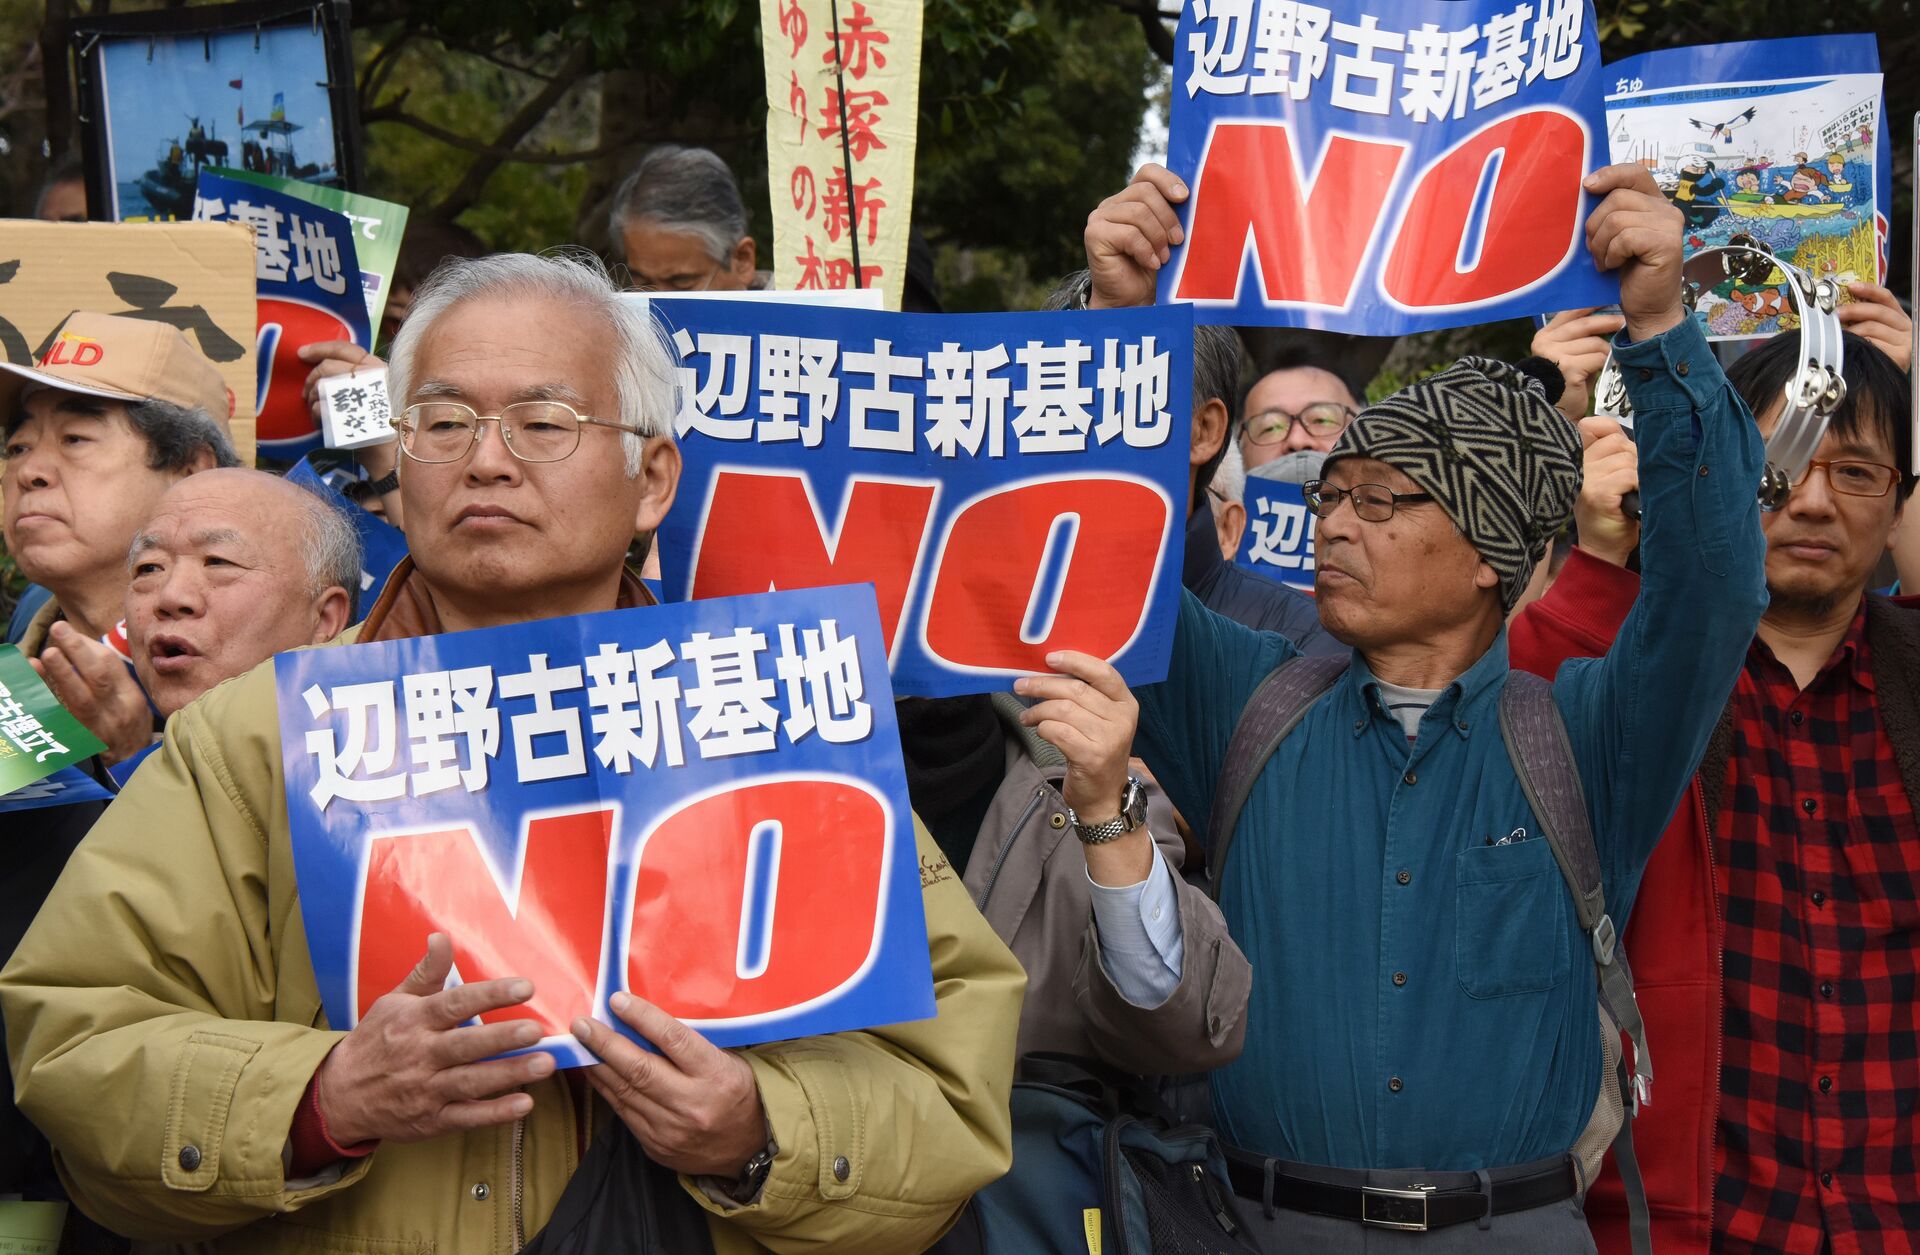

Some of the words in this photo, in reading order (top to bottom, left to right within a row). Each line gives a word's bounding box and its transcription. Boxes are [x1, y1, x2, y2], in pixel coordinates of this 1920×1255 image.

[1186, 0, 1583, 122] 辺野古新基地
[1173, 107, 1588, 310] NO
[672, 327, 1172, 457] 辺野古新基地
[690, 470, 1168, 675] NO
[1248, 496, 1317, 571] 辺
[303, 619, 872, 811] 辺野古新基地
[355, 777, 890, 1039] NO
